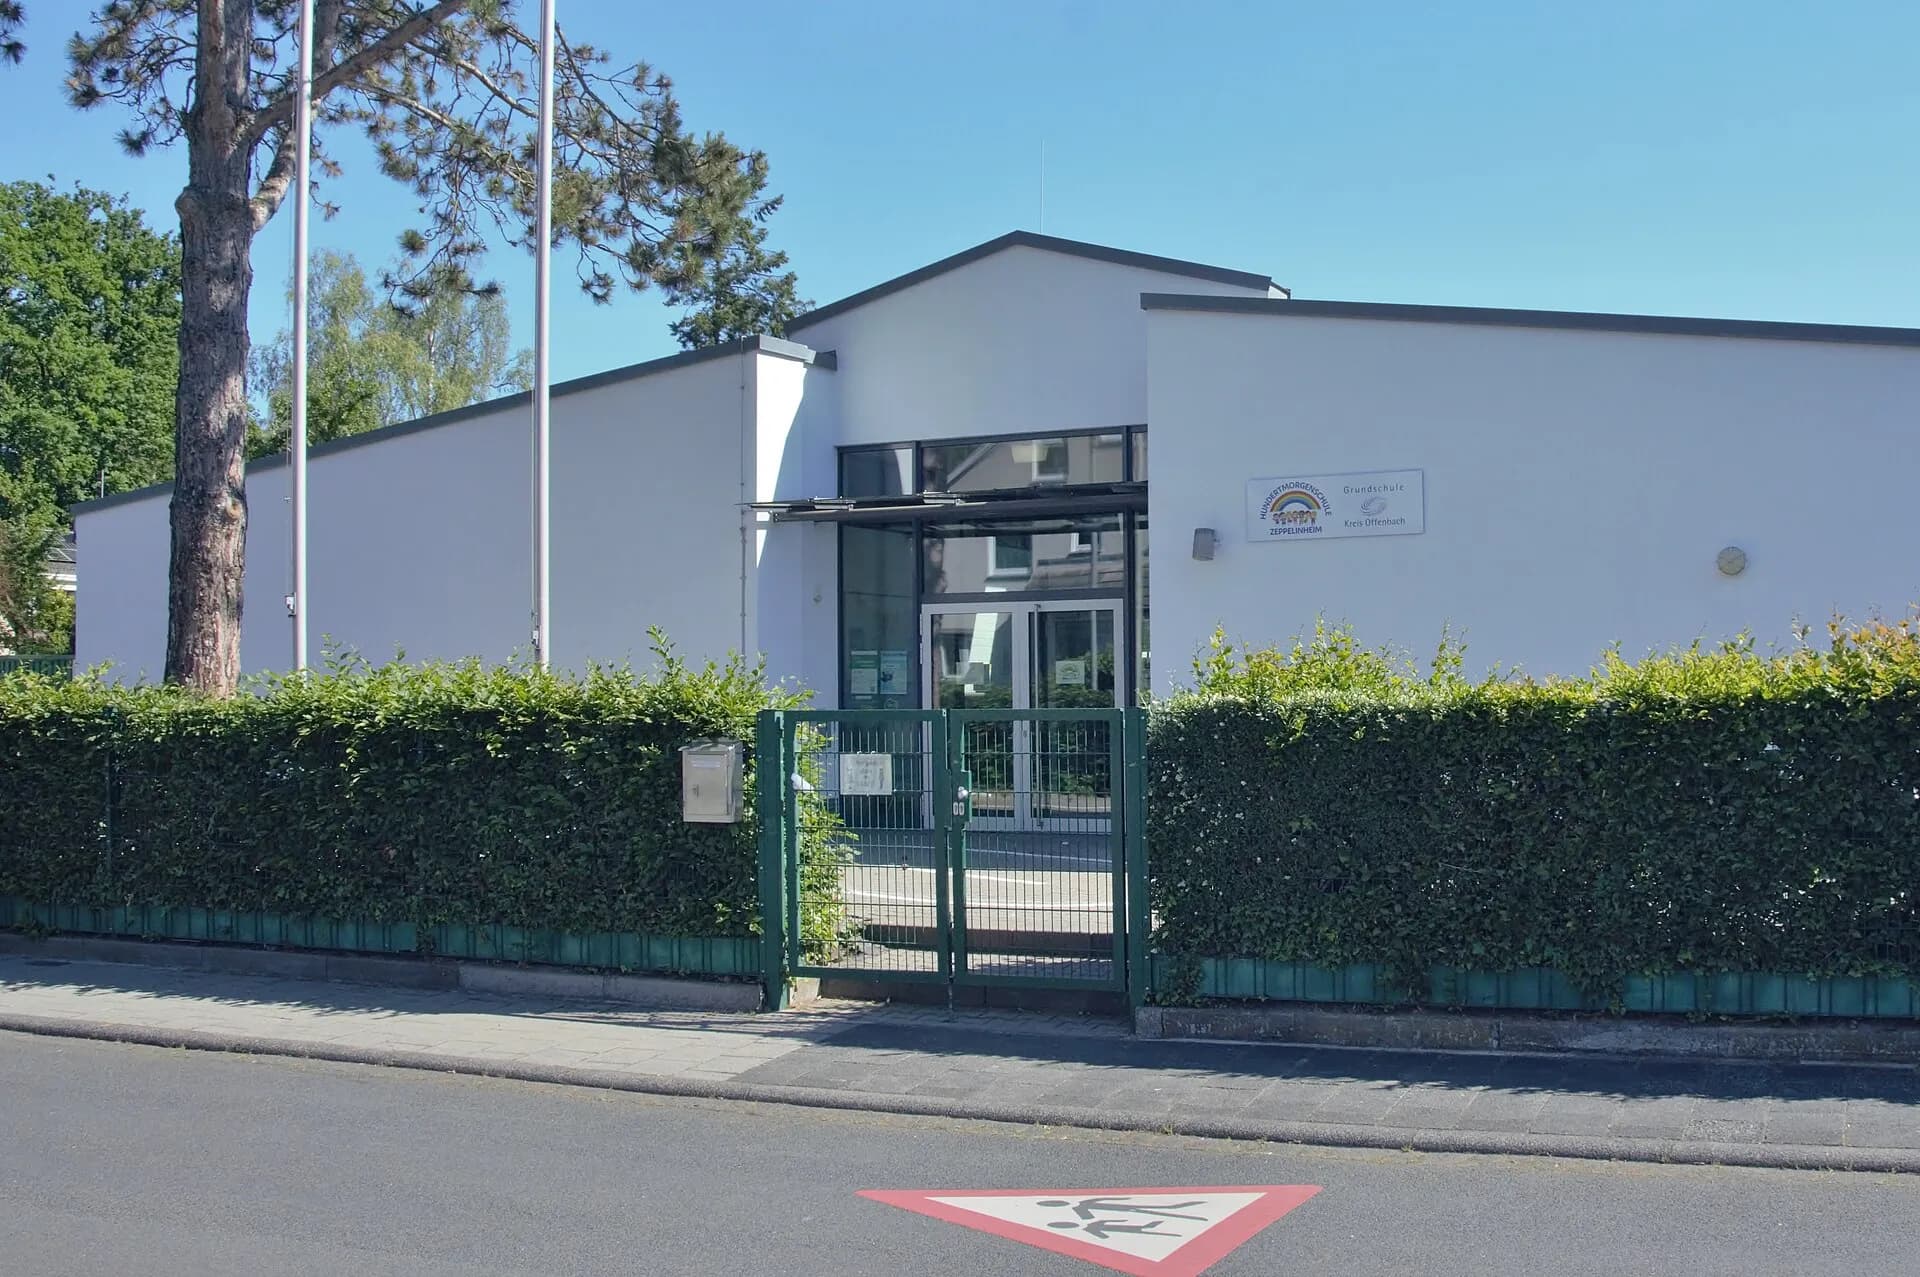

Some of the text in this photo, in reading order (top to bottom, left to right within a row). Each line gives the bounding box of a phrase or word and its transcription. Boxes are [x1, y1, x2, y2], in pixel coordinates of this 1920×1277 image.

[1343, 483, 1404, 495] Grundschule
[1260, 481, 1332, 520] HUNDERTMORGENSCHULE
[1344, 516, 1406, 528] Kreis Offenbach
[1270, 526, 1322, 536] ZEPPELINHEIM
